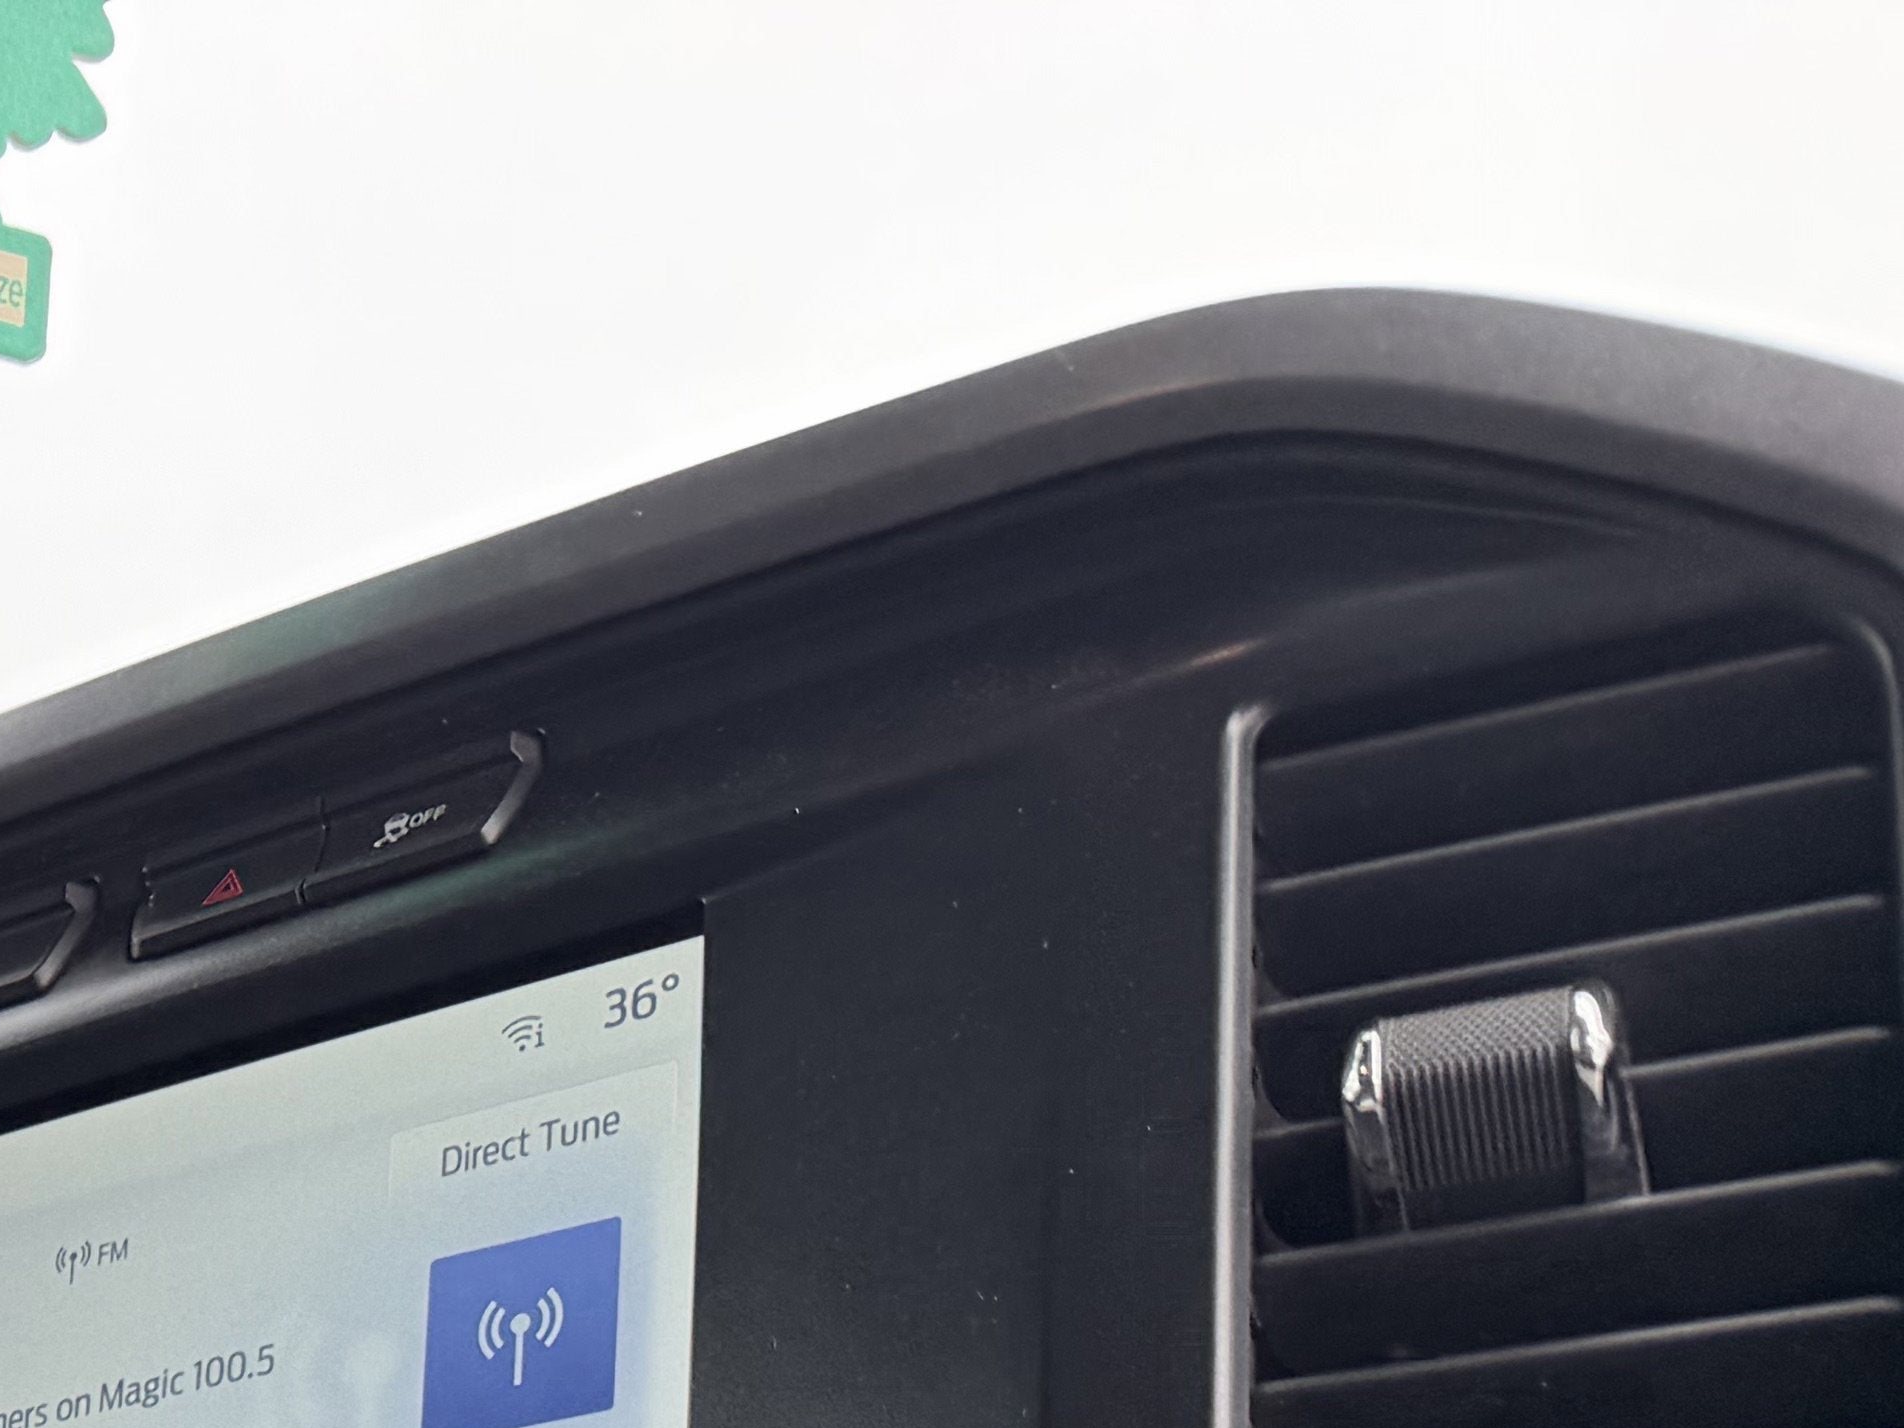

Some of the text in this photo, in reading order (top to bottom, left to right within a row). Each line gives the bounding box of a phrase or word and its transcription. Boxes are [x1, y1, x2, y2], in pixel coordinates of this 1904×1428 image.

[409, 804, 447, 828] OFF
[603, 973, 680, 1030] 36°
[441, 1109, 620, 1177] Direct Tune
[97, 1237, 129, 1267] FM
[56, 1393, 91, 1422] on
[98, 1368, 184, 1413] Magic
[192, 1343, 276, 1391] 100.5
